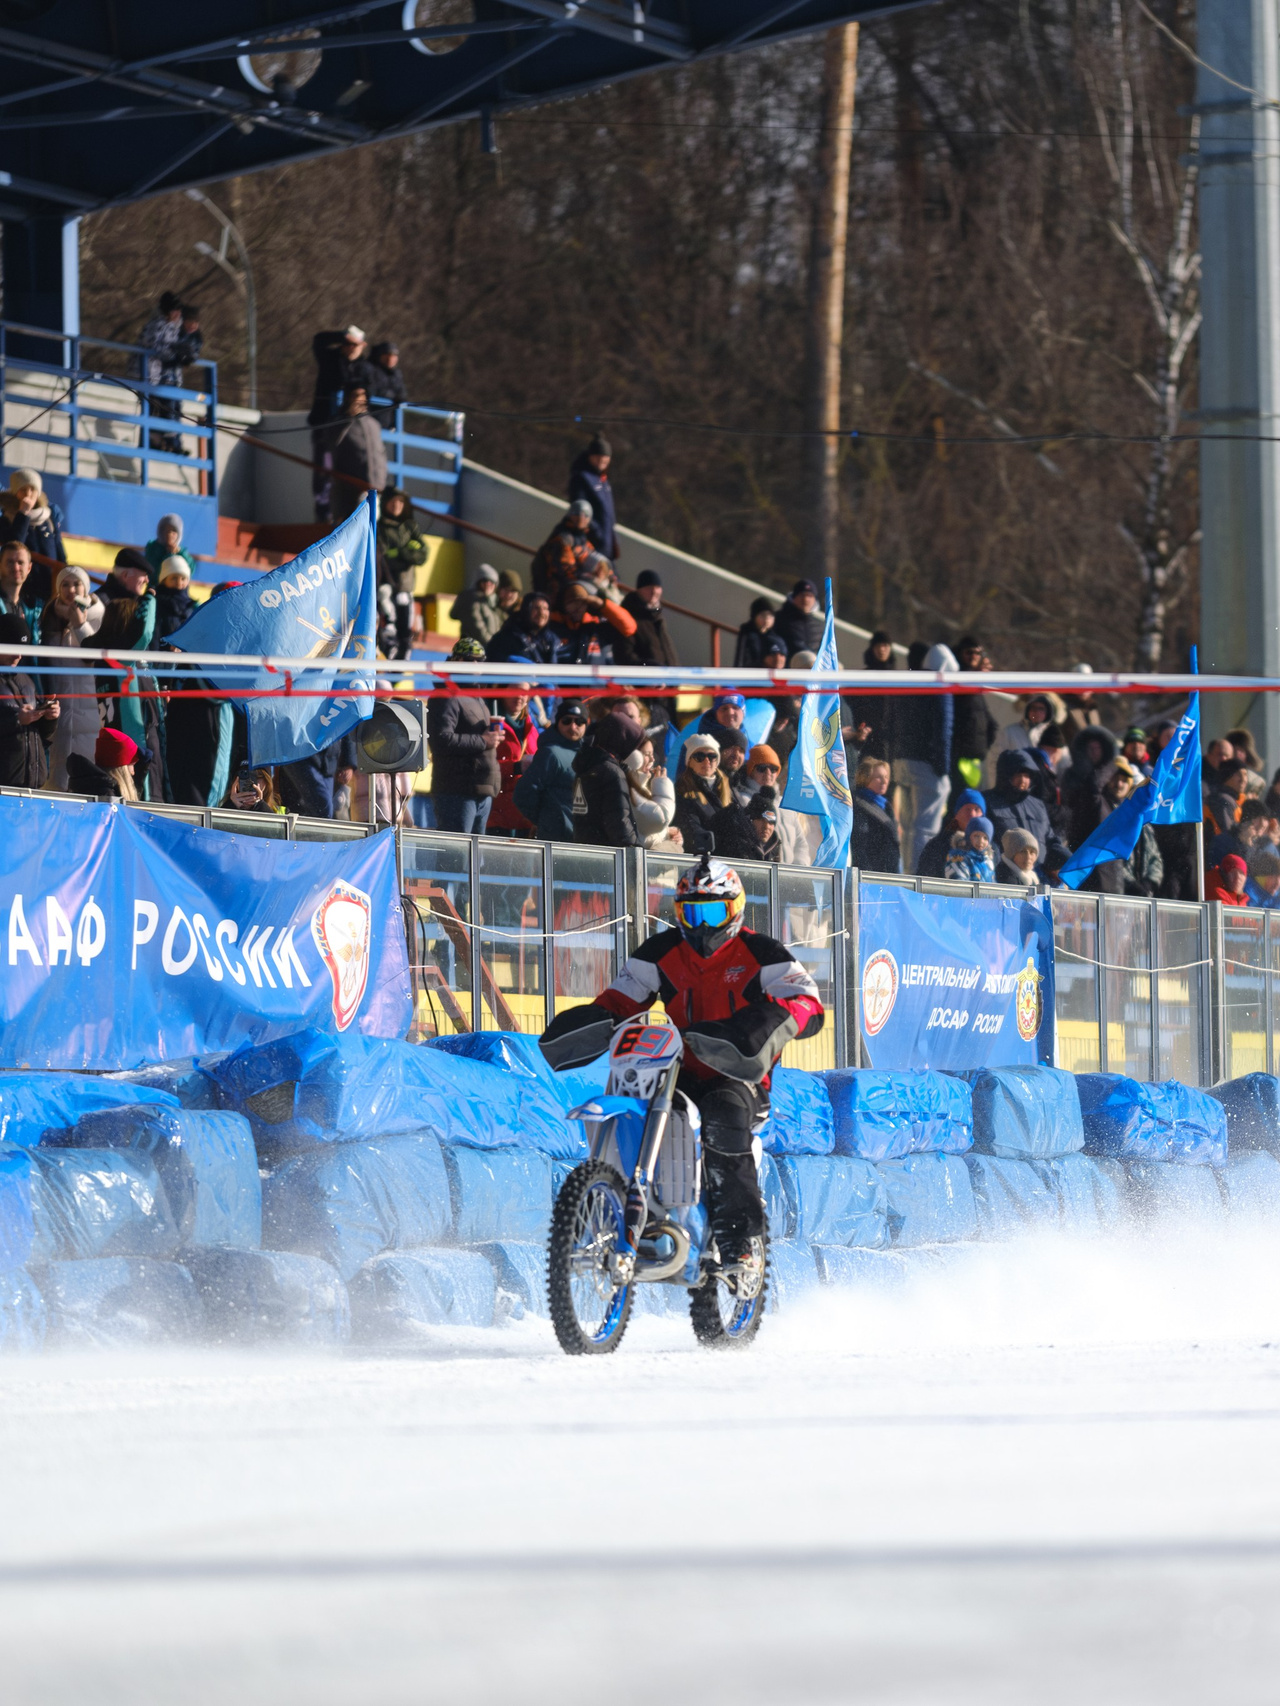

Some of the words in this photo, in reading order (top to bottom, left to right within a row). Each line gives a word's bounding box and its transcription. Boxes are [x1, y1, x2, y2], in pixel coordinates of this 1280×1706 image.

[0, 894, 106, 967] ААФ
[131, 898, 313, 989] РОССИИ
[901, 963, 982, 989] ЦЕНТРАЛЬНЫЙ
